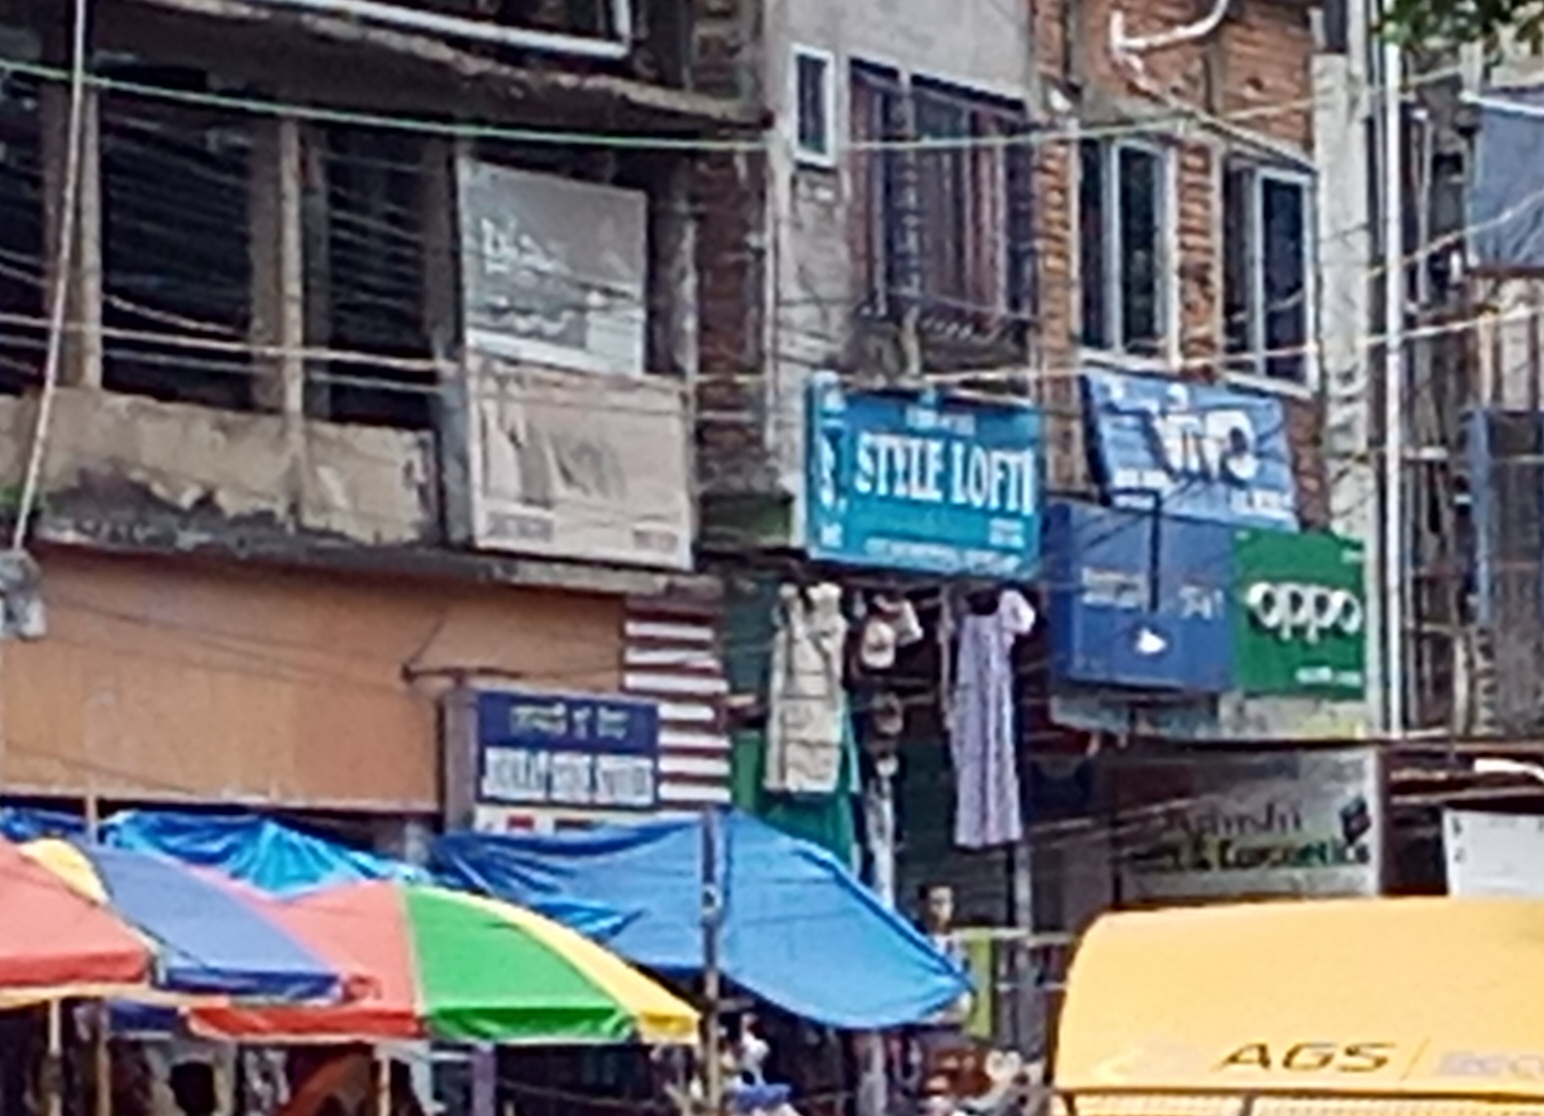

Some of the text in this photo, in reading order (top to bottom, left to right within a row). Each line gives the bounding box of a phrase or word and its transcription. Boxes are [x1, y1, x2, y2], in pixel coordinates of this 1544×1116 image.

[856, 432, 943, 502] STYLE
[1248, 581, 1362, 641] oppo
[1218, 1042, 1397, 1073] AGS
